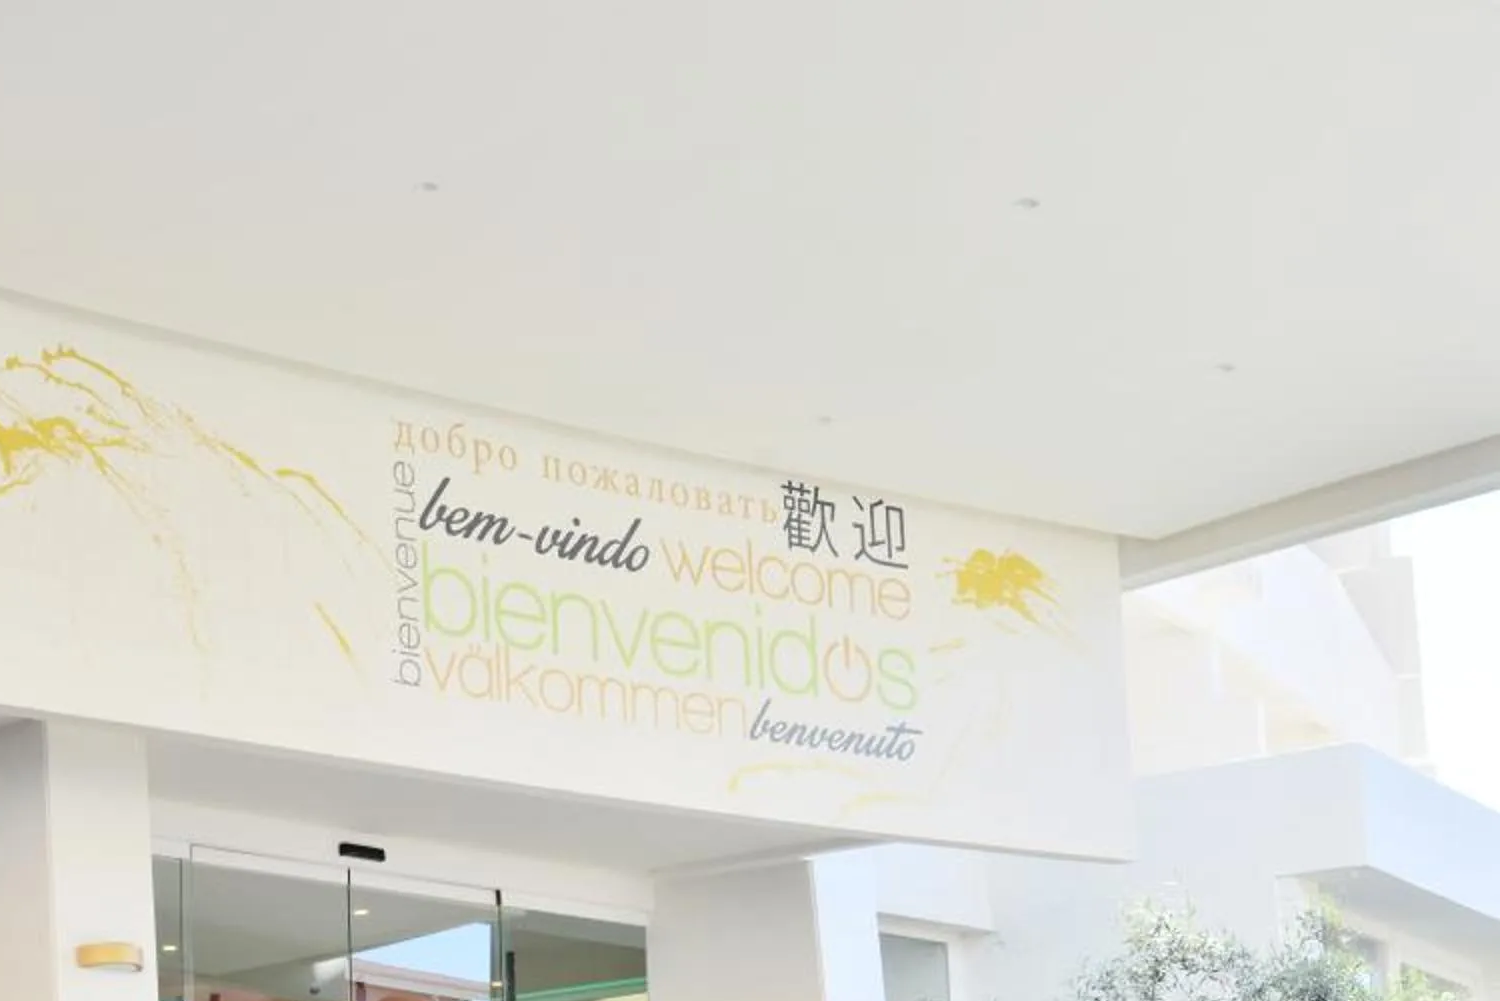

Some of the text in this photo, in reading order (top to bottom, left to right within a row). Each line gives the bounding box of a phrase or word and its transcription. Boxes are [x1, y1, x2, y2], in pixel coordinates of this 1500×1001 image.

[394, 420, 781, 524] добро пожаловать
[392, 460, 422, 687] bienvenue
[418, 476, 650, 573] bem-vindo
[779, 479, 910, 571] 歡迎
[421, 538, 918, 712] bienvenidos
[659, 537, 913, 621] welcome
[423, 641, 748, 740] välkommen
[749, 696, 924, 762] benvenuto
